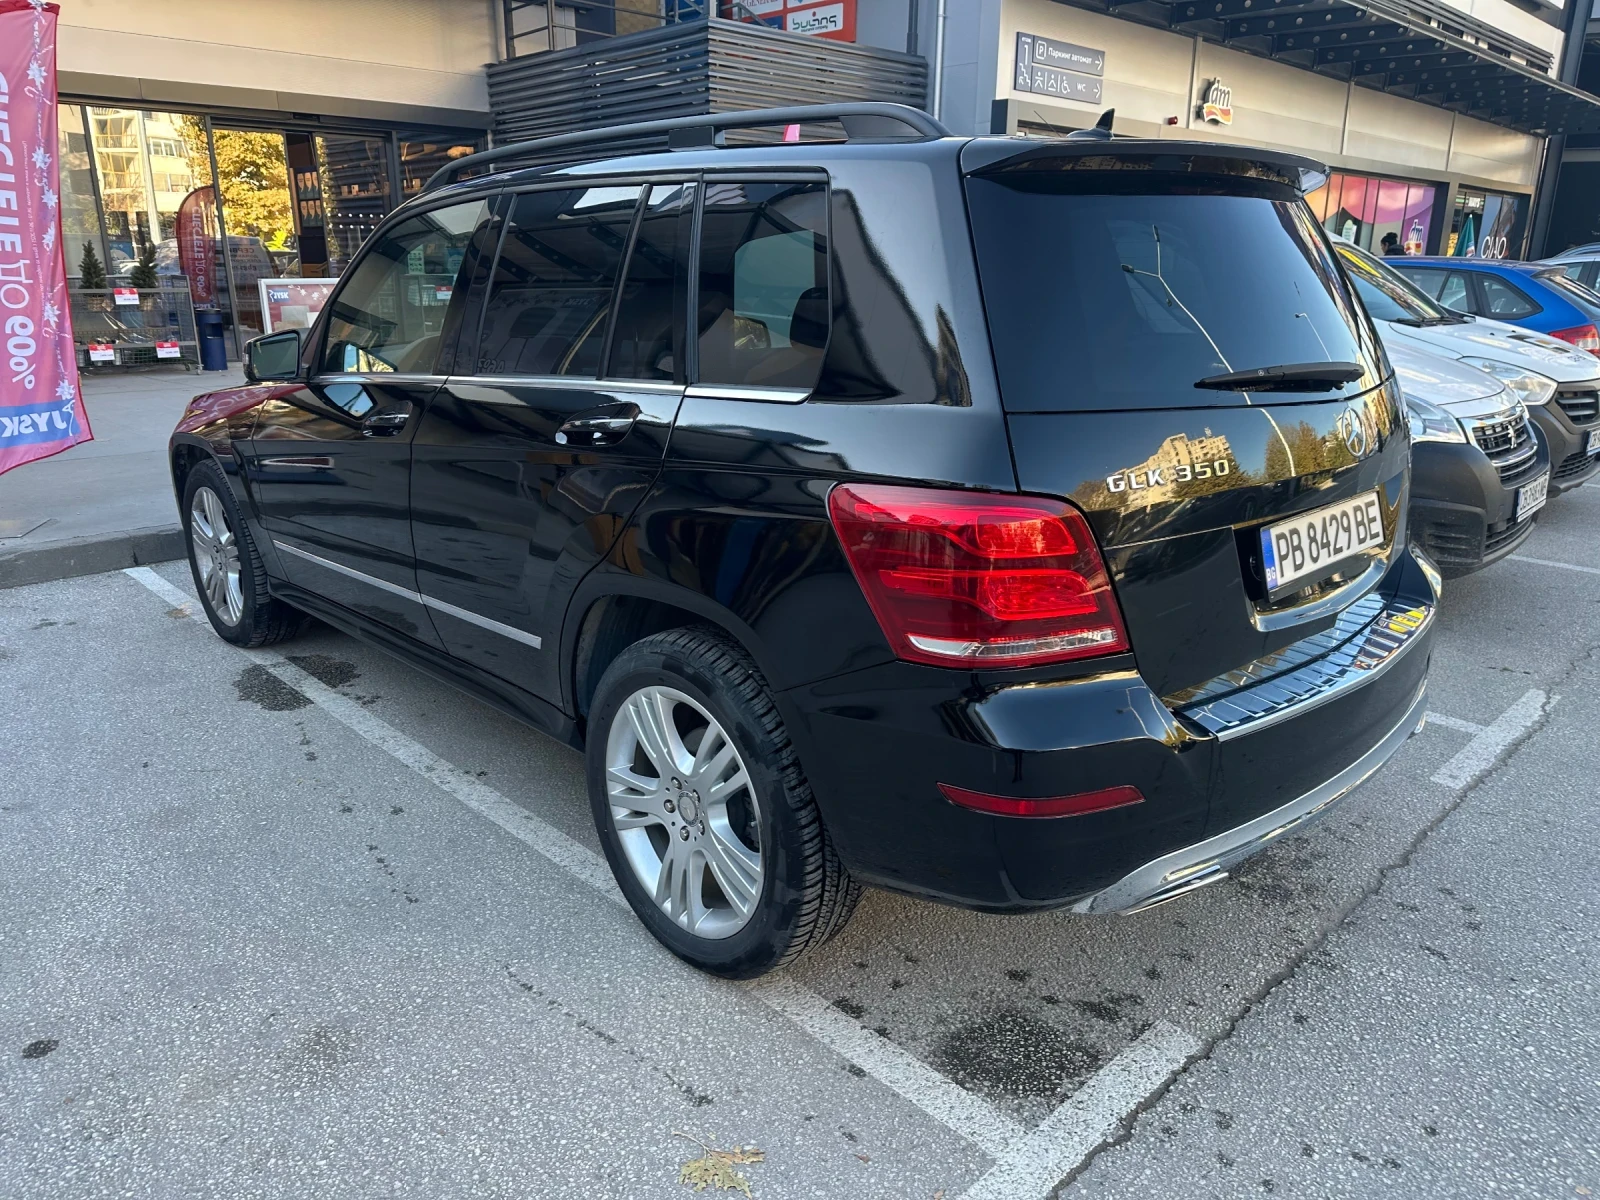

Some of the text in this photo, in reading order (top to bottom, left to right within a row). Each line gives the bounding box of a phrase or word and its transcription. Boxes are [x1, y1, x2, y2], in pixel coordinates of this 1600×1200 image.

[1048, 46, 1092, 64] Паркинг автомат
[1076, 82, 1087, 92] WC
[1210, 79, 1231, 108] dm
[274, 291, 289, 299] JYSK
[1106, 460, 1230, 493] GLK 350
[1275, 499, 1381, 579] PB 8429 BE
[1266, 567, 1277, 581] BG
